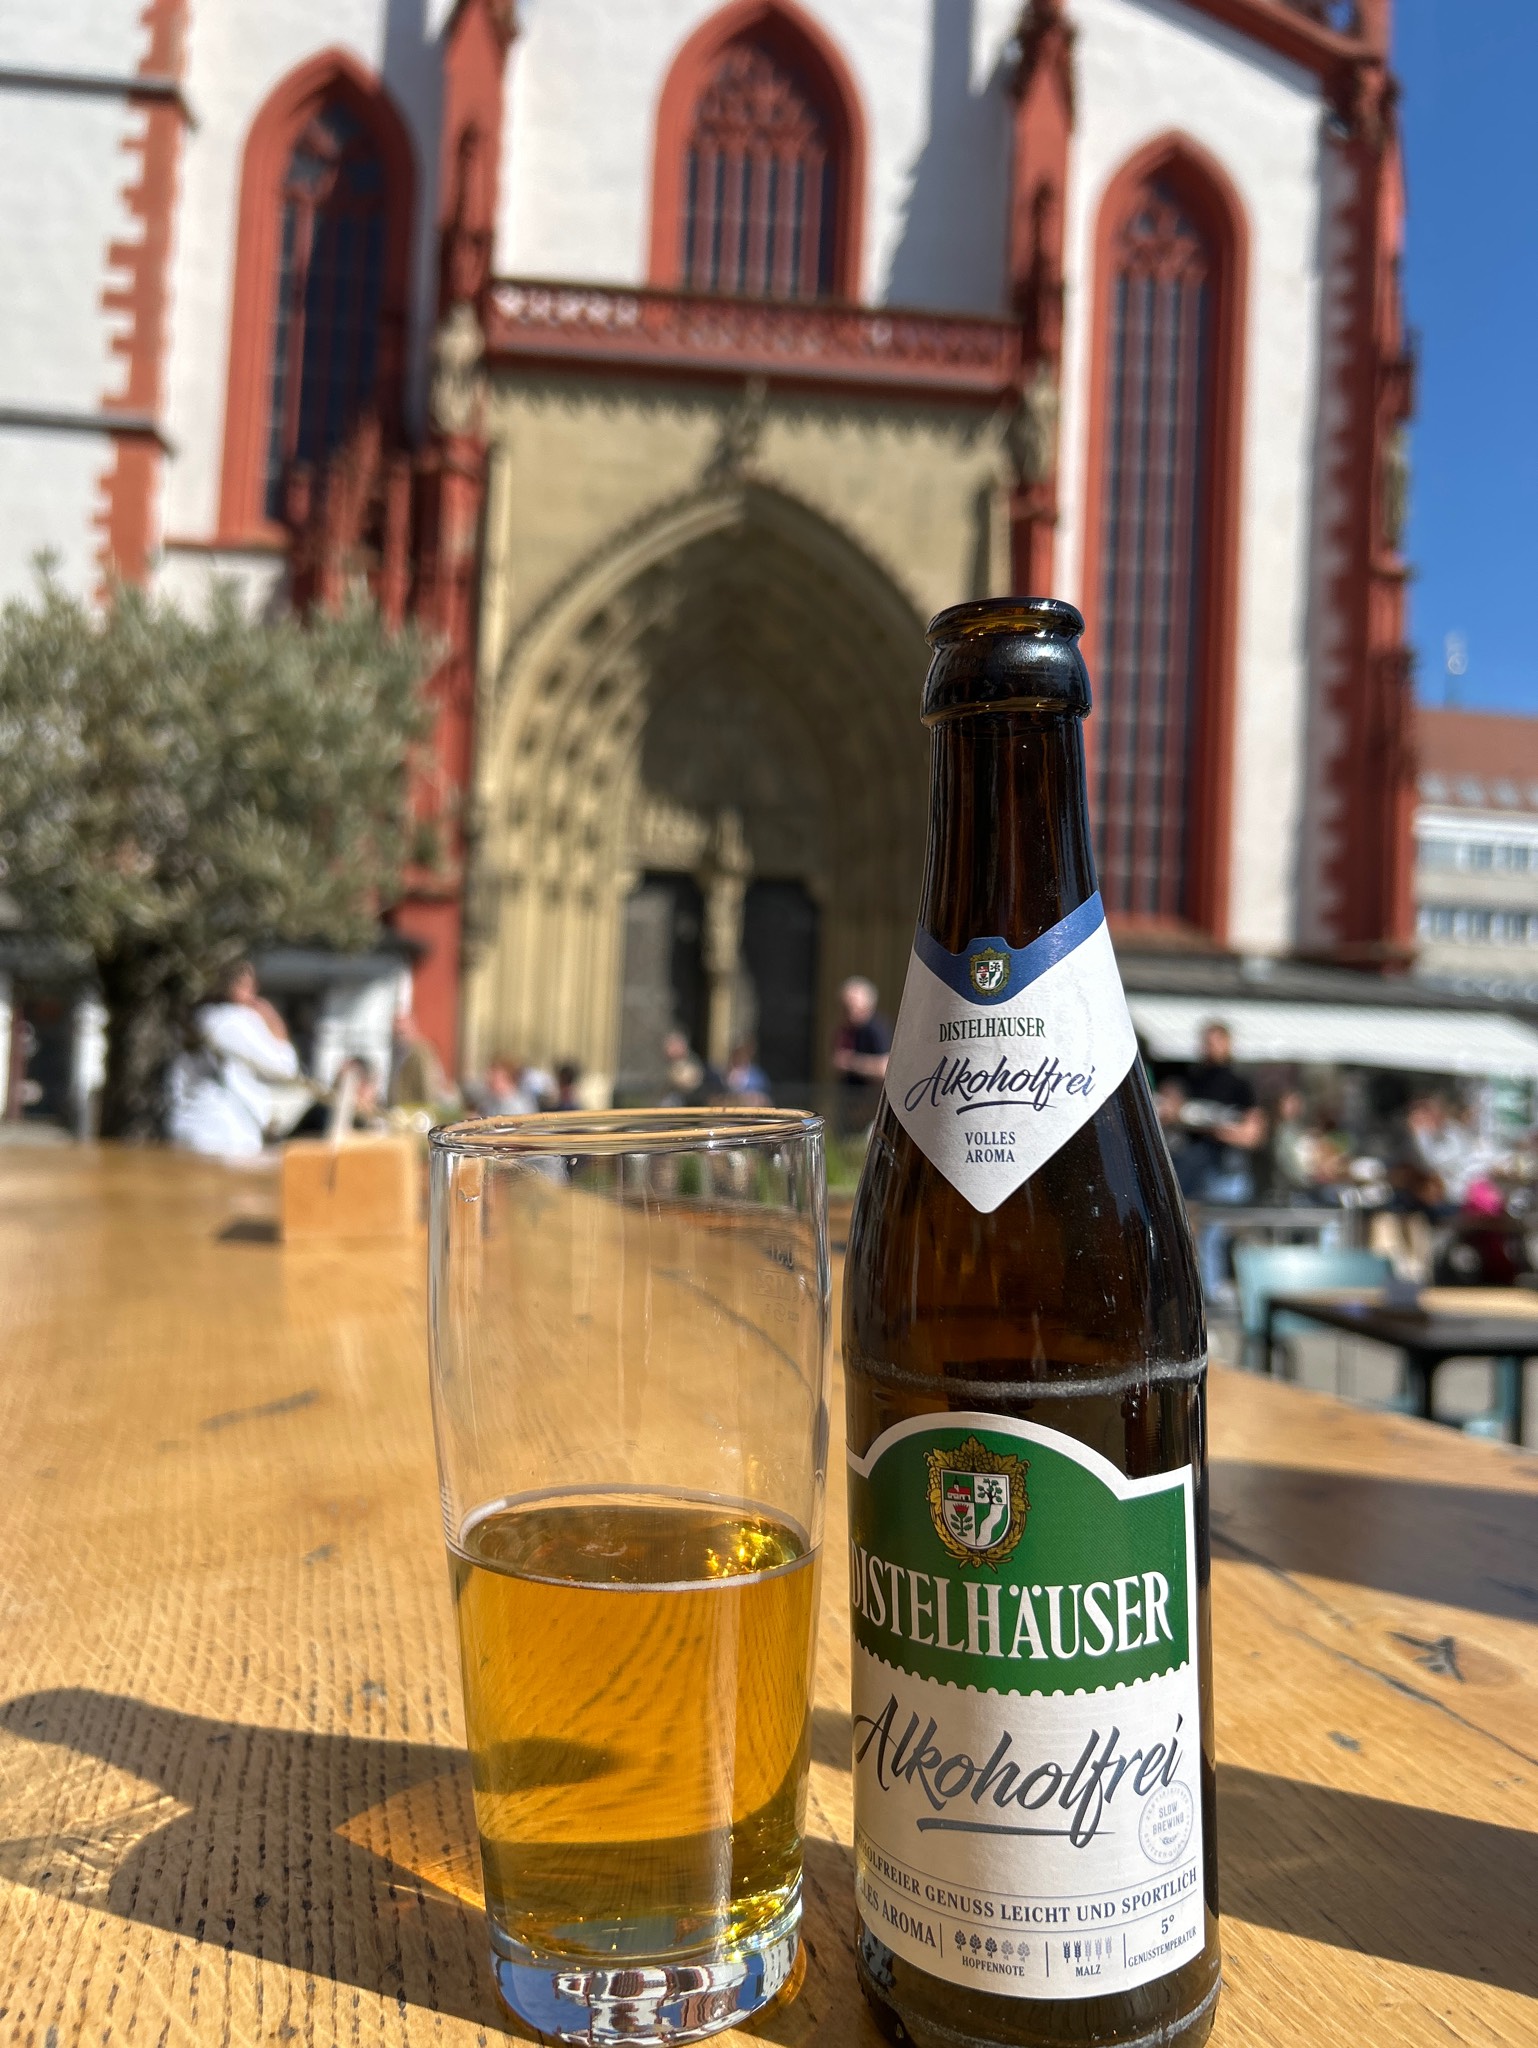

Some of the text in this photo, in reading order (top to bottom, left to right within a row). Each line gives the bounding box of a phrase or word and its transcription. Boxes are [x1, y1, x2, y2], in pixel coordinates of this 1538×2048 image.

[939, 1017, 1046, 1043] DISTELHÄUSER
[904, 1055, 1096, 1112] Alkoholfrei
[964, 1131, 1016, 1146] VOLLES
[965, 1149, 1016, 1164] AROMA
[851, 1537, 1174, 1660] DISTELHÄUSER
[854, 1693, 1184, 1848] Alkoholfrei
[1158, 1801, 1178, 1819] SLOW
[925, 1884, 995, 1918] GENUSS
[1000, 1904, 1070, 1923] LEICHT
[1077, 1902, 1116, 1922] UND
[1121, 1866, 1198, 1914] SPORTLICH
[860, 1876, 936, 1948] LES AROMA
[1161, 1914, 1175, 1935] 5°
[1127, 1926, 1197, 1968] GENUSSTEMPERATUR
[961, 1955, 1025, 1978] HOPFENNOTE
[1075, 1964, 1102, 1978] MALZ
